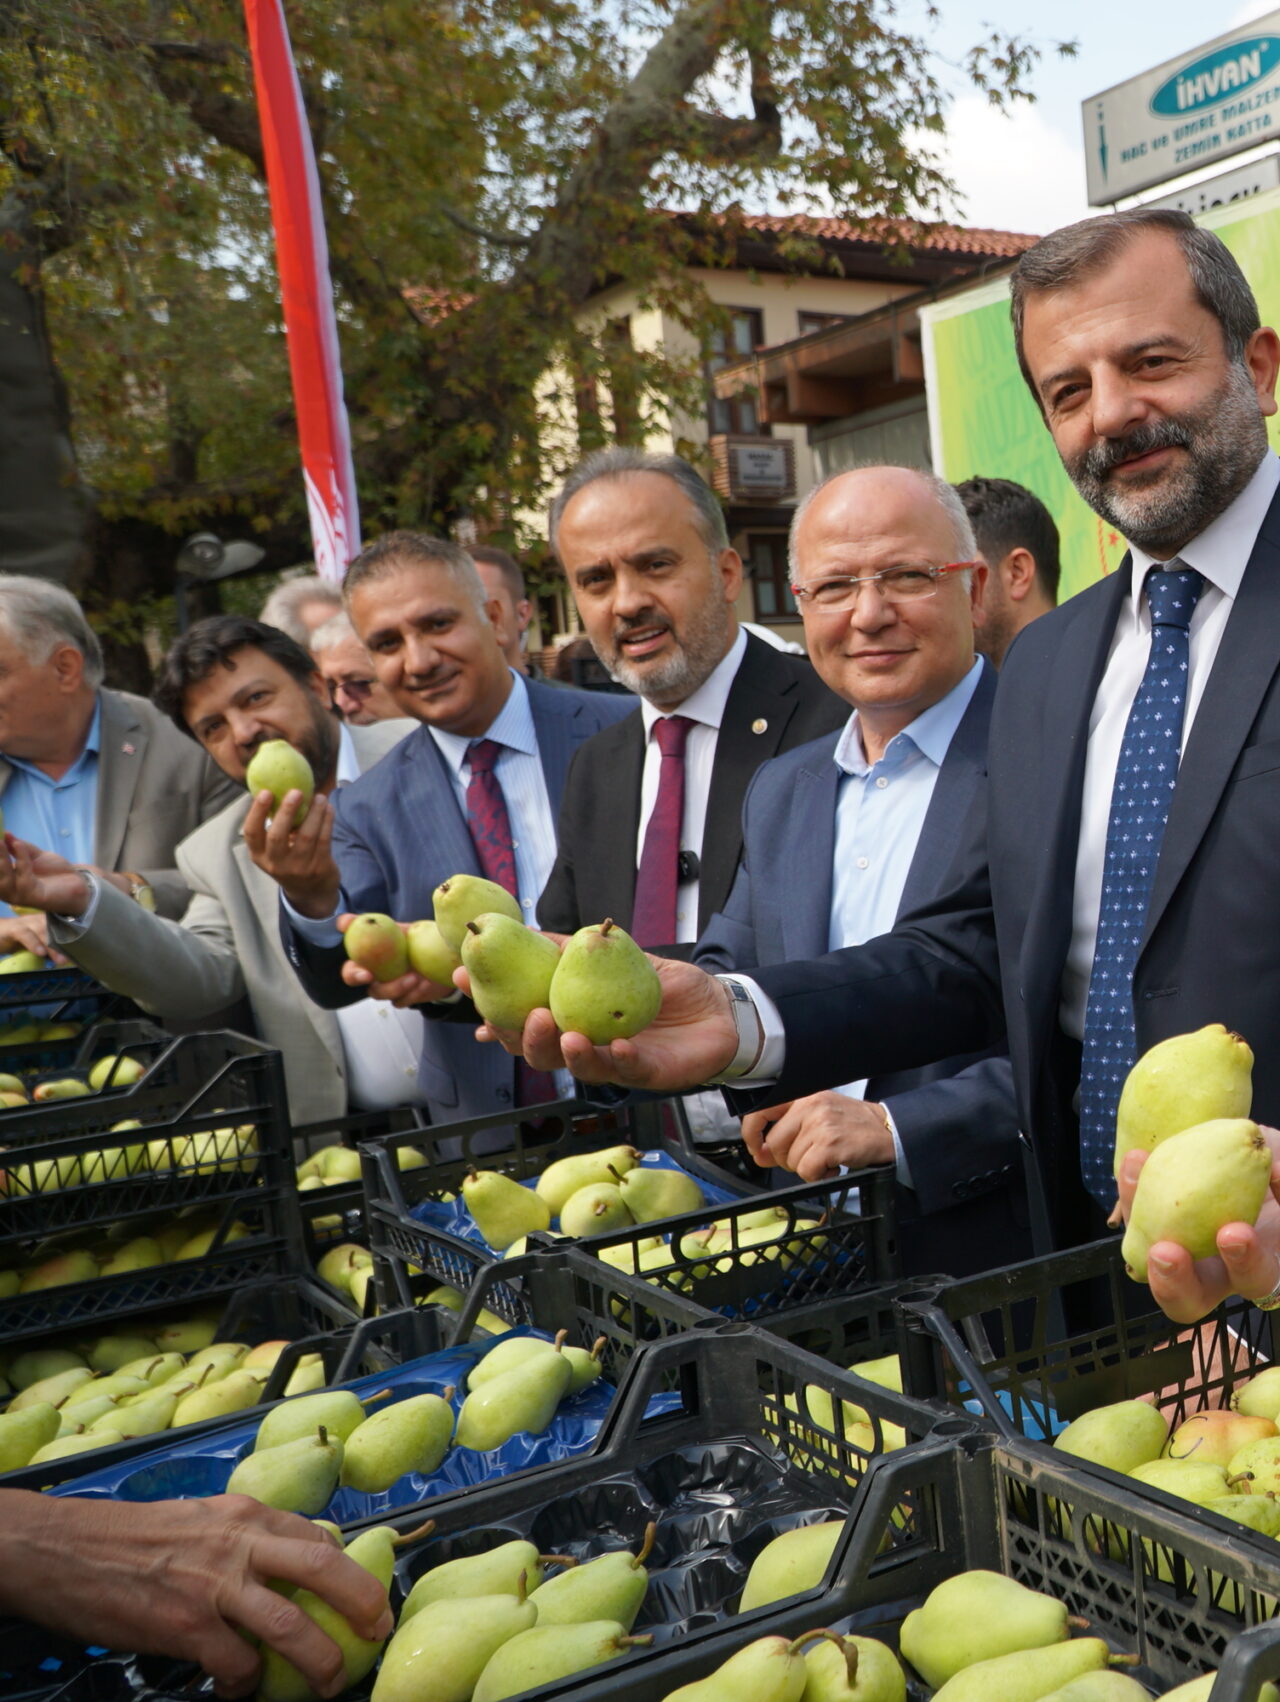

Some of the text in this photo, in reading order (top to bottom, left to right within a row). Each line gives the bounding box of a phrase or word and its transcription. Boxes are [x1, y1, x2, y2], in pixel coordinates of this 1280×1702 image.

[1176, 49, 1262, 110] İHVAN
[1175, 114, 1273, 164] ZEMİN KATTA
